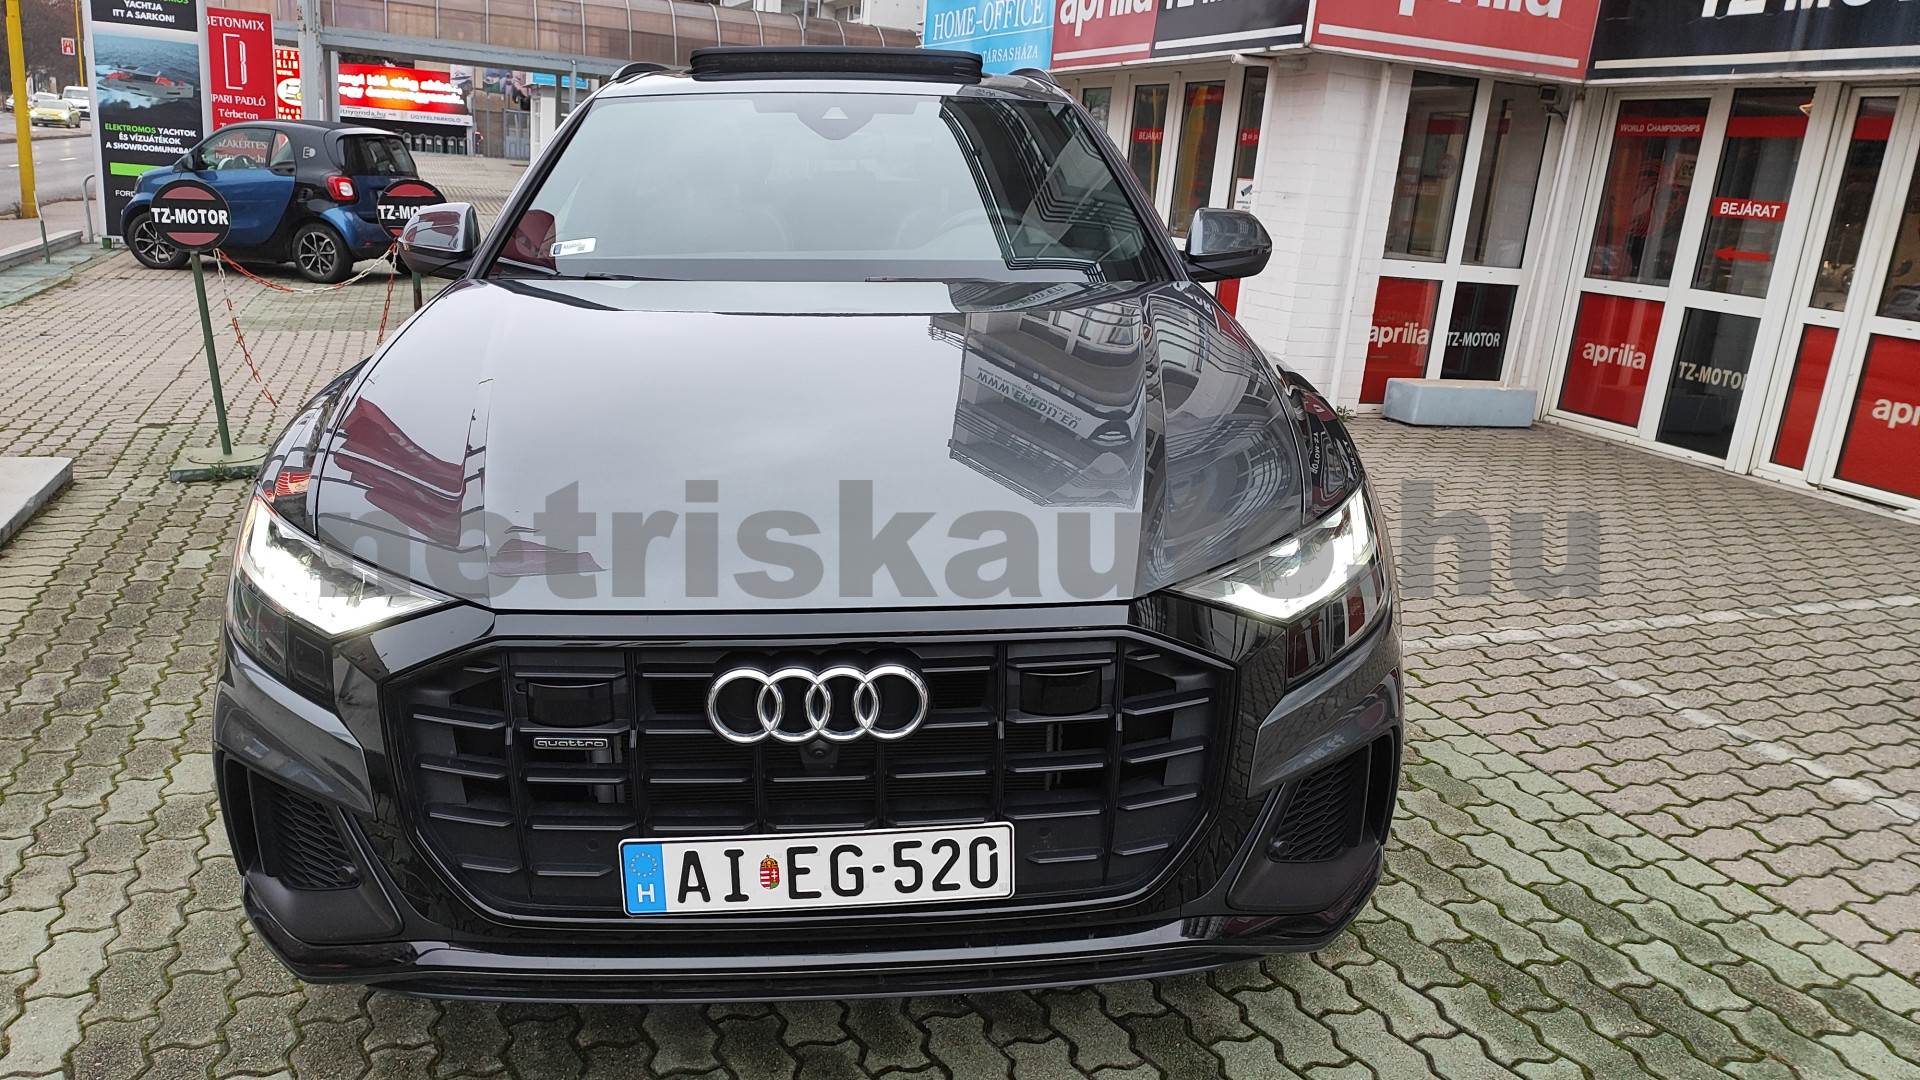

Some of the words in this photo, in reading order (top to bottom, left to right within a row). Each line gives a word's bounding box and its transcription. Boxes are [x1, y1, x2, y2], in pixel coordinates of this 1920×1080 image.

[123, 0, 163, 11] YACHTJA
[112, 9, 125, 17] ITT
[126, 10, 134, 18] A
[134, 11, 175, 23] SARKON!
[932, 0, 1045, 40] HOME-OFFICE
[235, 96, 266, 107] PADLÓ
[218, 108, 259, 120] Térbeton
[104, 123, 157, 134] ELEKTROMOS
[157, 127, 197, 137] YACHTOK
[1646, 123, 1700, 133] CHAMPIONSHIPS
[118, 133, 129, 141] ÉS
[151, 206, 229, 225] TZ-MOTOR
[377, 205, 430, 220] TZ-MO
[1720, 200, 1780, 218] BEJÁRAT
[1369, 322, 1430, 348] aprilia
[1447, 331, 1500, 347] TZ-MOTOR
[1582, 341, 1646, 370] aprilia
[537, 740, 604, 748] quattro
[677, 848, 750, 904] AI
[786, 835, 999, 899] EG-520
[636, 883, 656, 903] H
